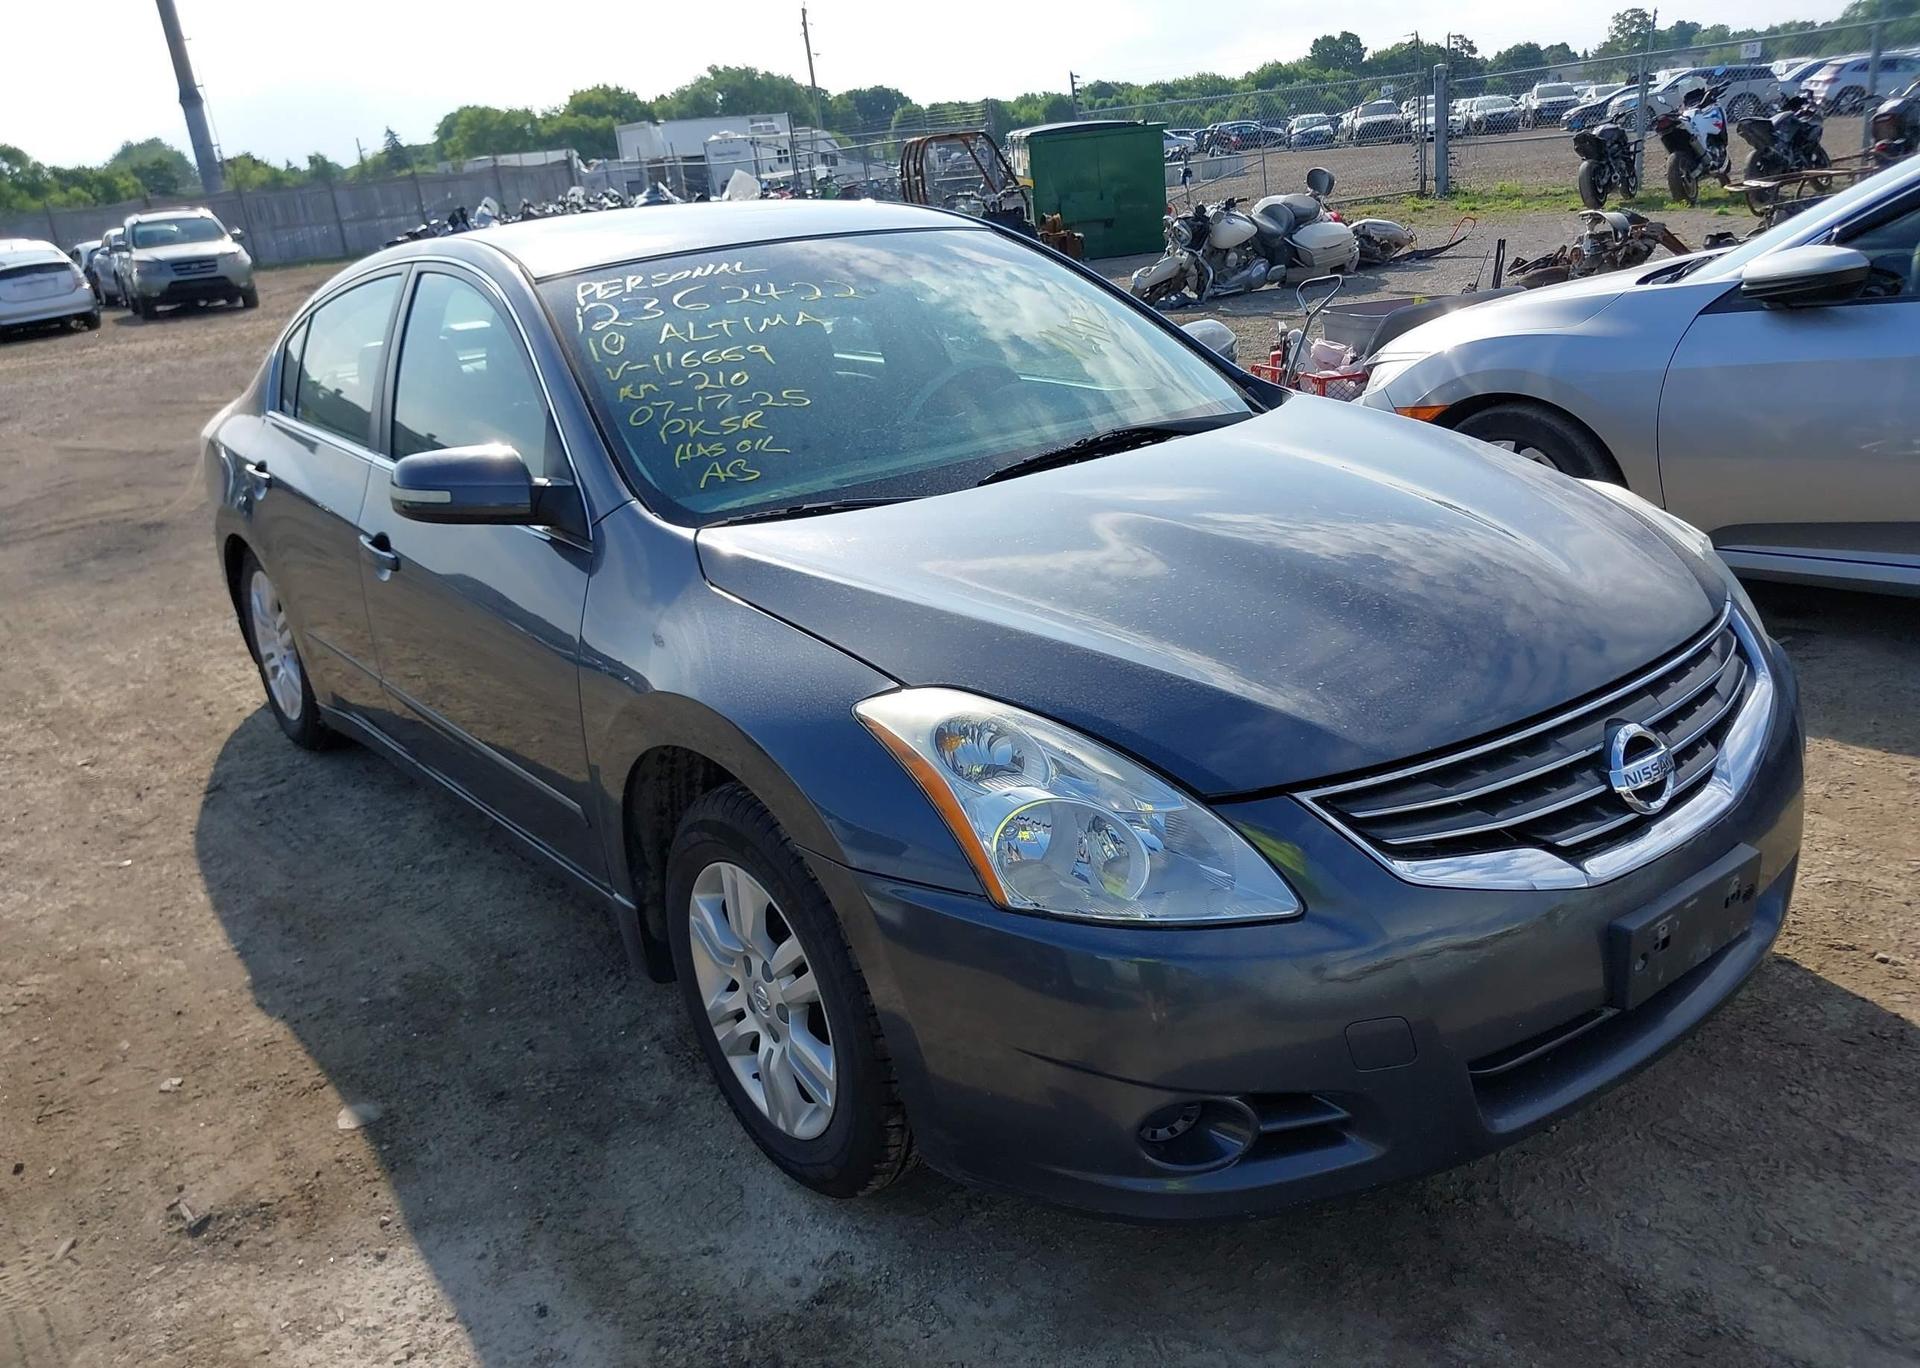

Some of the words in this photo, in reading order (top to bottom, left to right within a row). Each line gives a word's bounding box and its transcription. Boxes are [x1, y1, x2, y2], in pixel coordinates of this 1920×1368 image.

[576, 261, 768, 306] PERSONAL
[588, 331, 625, 362] 10
[659, 311, 829, 344] ALTIMA
[629, 389, 812, 426] 07-17-25
[675, 442, 727, 468] HAS
[736, 435, 791, 453] OIL
[700, 458, 761, 489] AB
